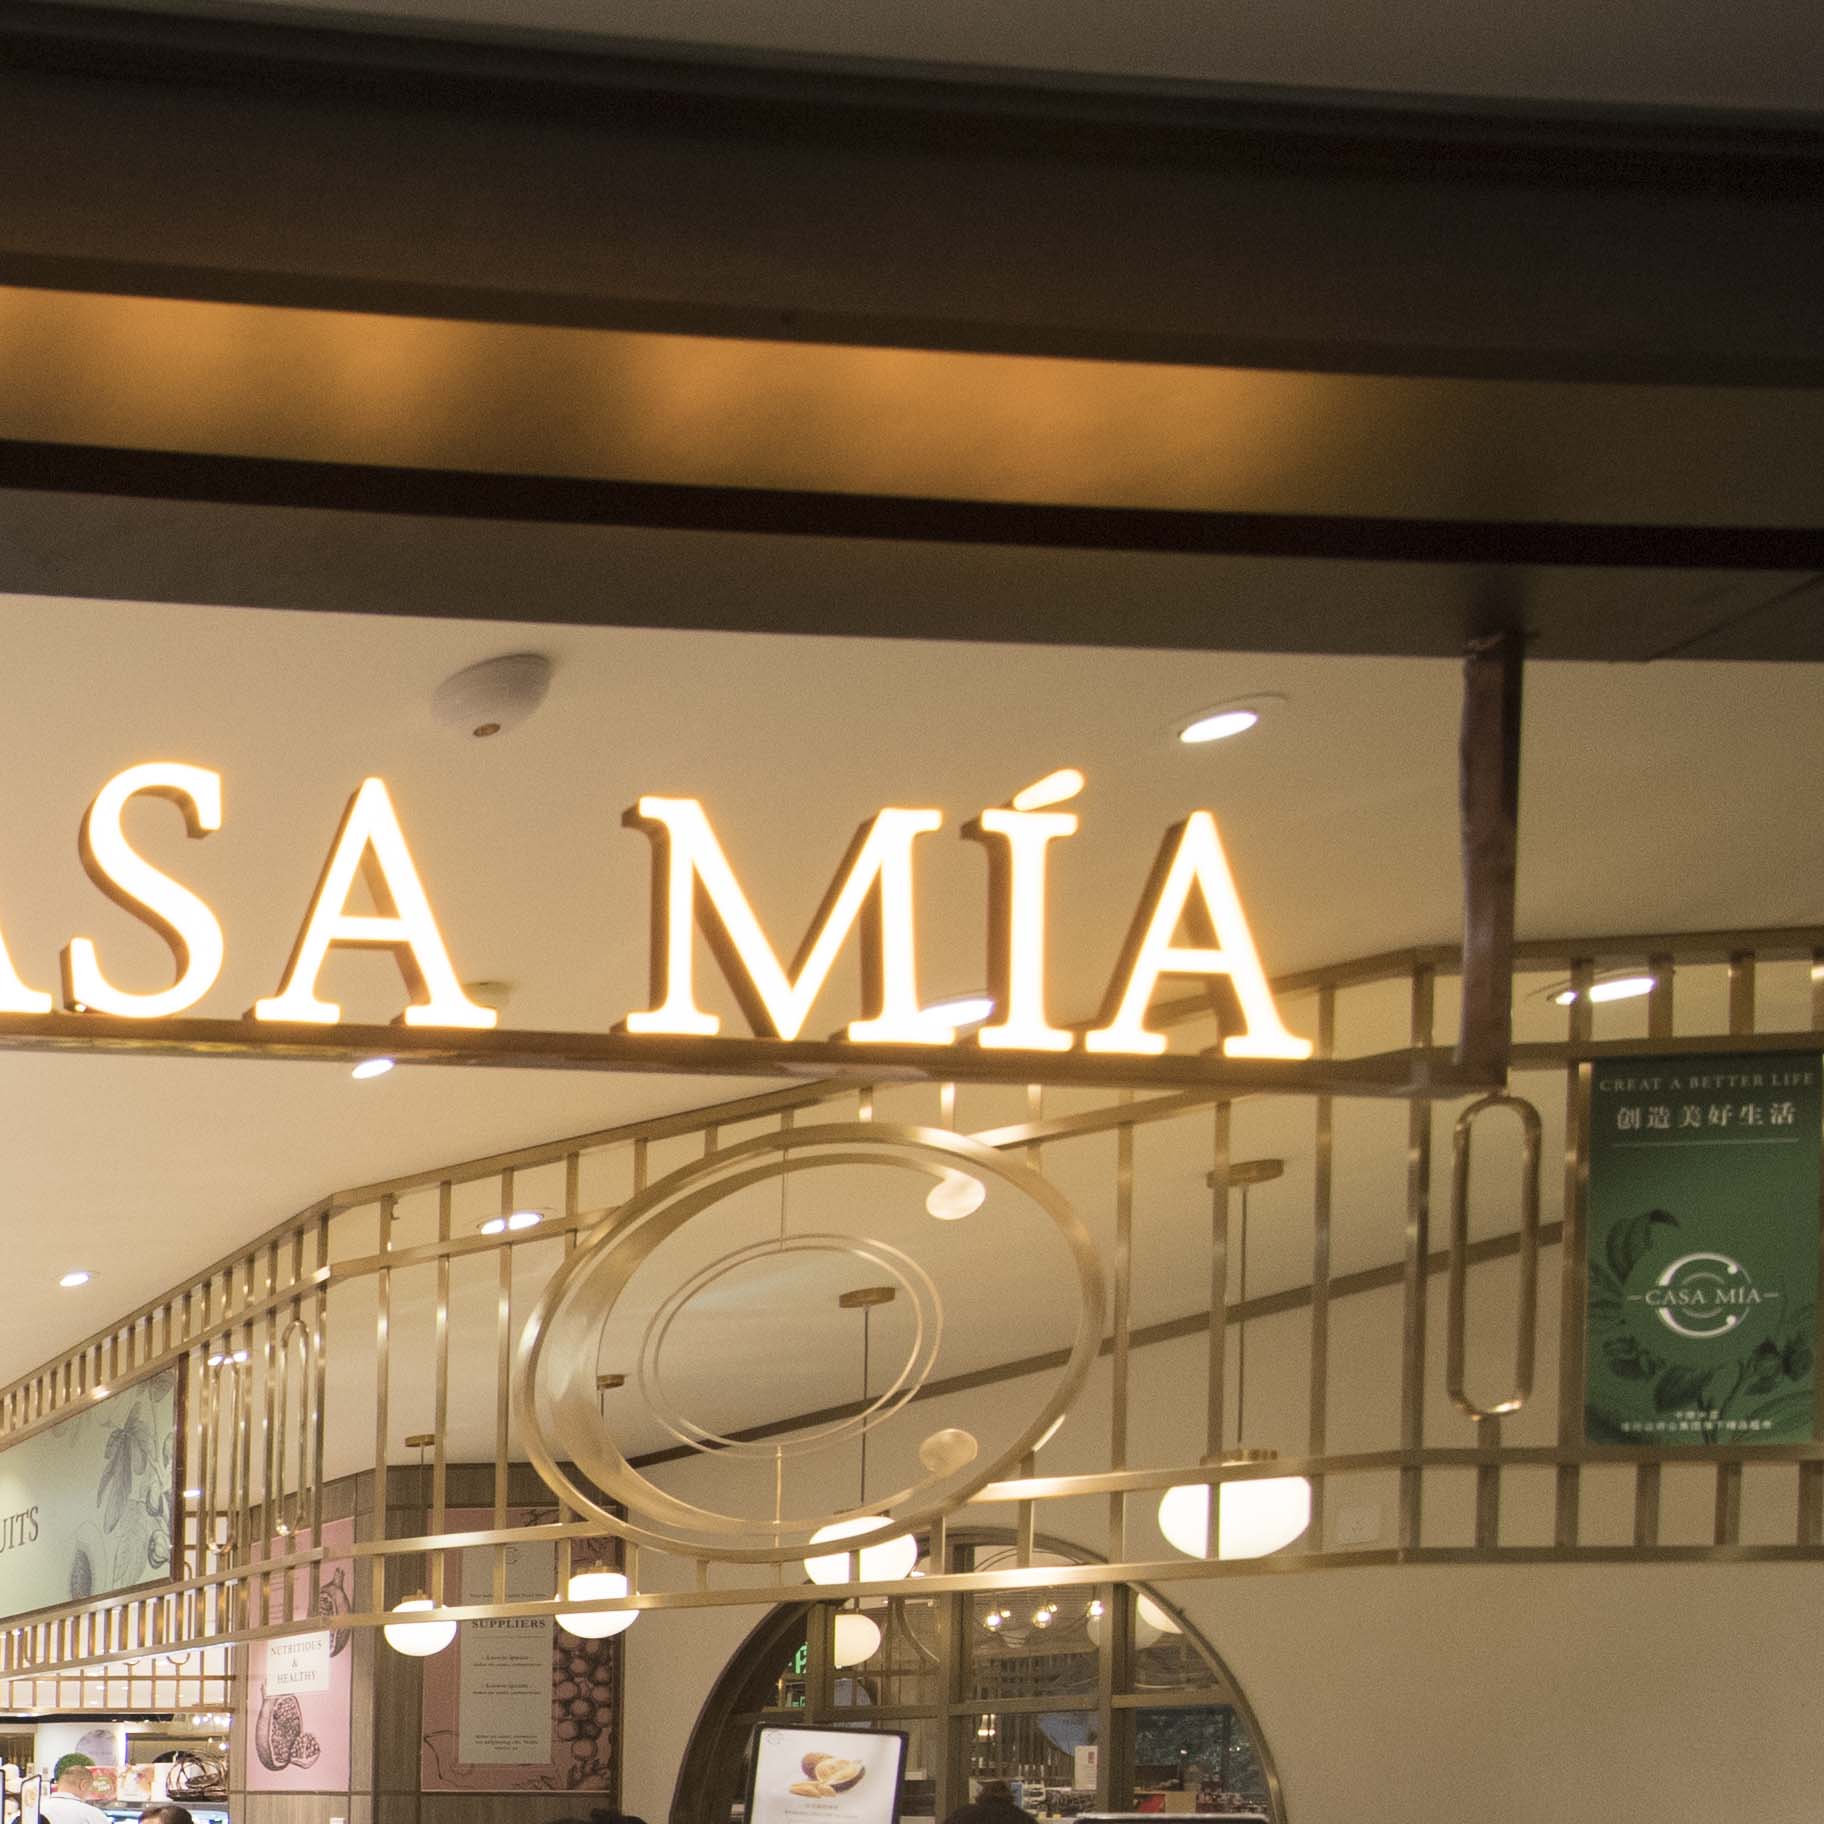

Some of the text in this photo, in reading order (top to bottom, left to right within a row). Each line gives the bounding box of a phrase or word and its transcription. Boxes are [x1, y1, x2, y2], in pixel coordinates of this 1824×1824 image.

[624, 766, 1313, 1060] MÍA
[1599, 1071, 1815, 1092] CREAT A BETTER LIFE
[1616, 1102, 1796, 1131] 创造美好生活
[1645, 1289, 1705, 1306] CASA
[471, 1618, 547, 1630] SUPPLIERS
[270, 1639, 323, 1656] NUTRITIOUS
[276, 1670, 318, 1684] HEALTHY
